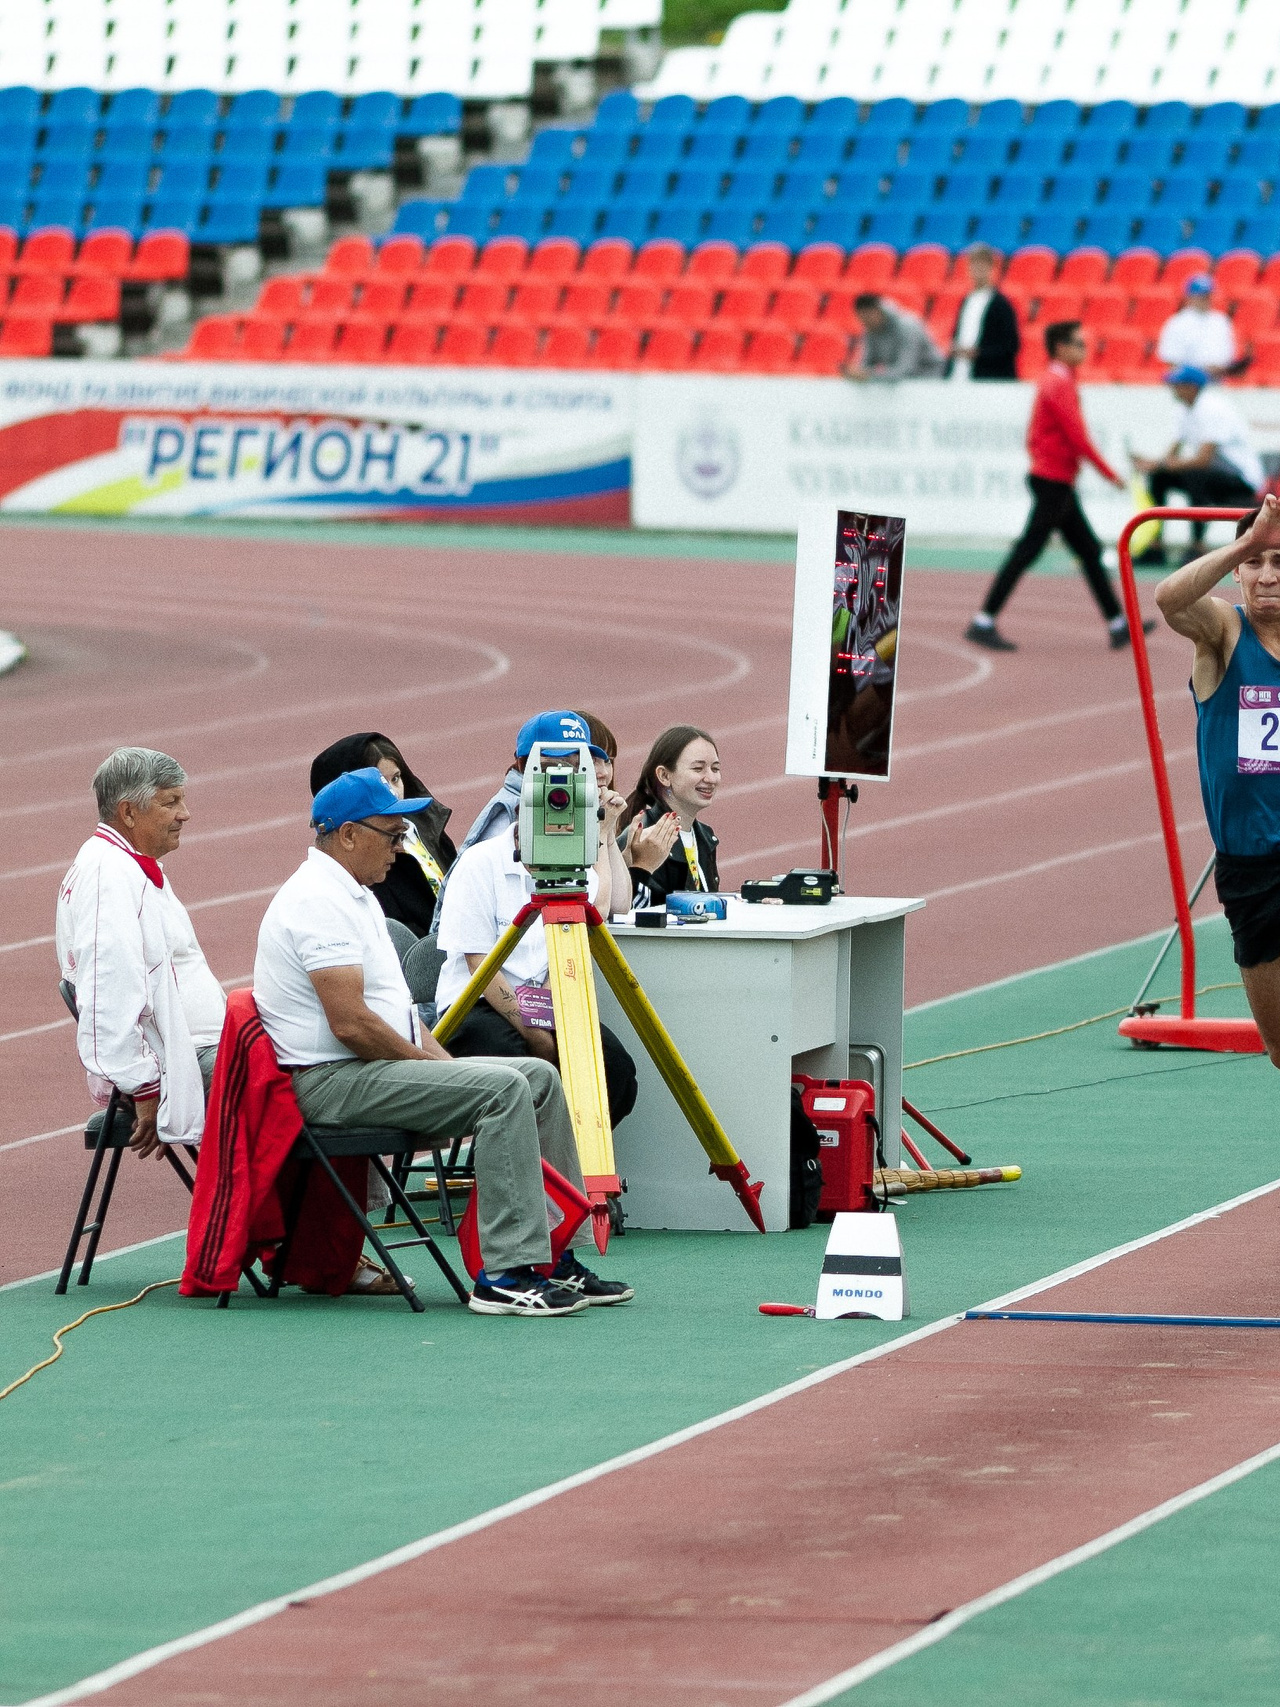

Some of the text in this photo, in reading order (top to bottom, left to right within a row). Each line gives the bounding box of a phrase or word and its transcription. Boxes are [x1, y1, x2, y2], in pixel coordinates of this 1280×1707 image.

[124, 424, 501, 484] "РЕГИОН 21"
[564, 958, 576, 981] Leica
[530, 1017, 552, 1027] СУДЬЯ
[832, 1288, 883, 1299] MONDO
